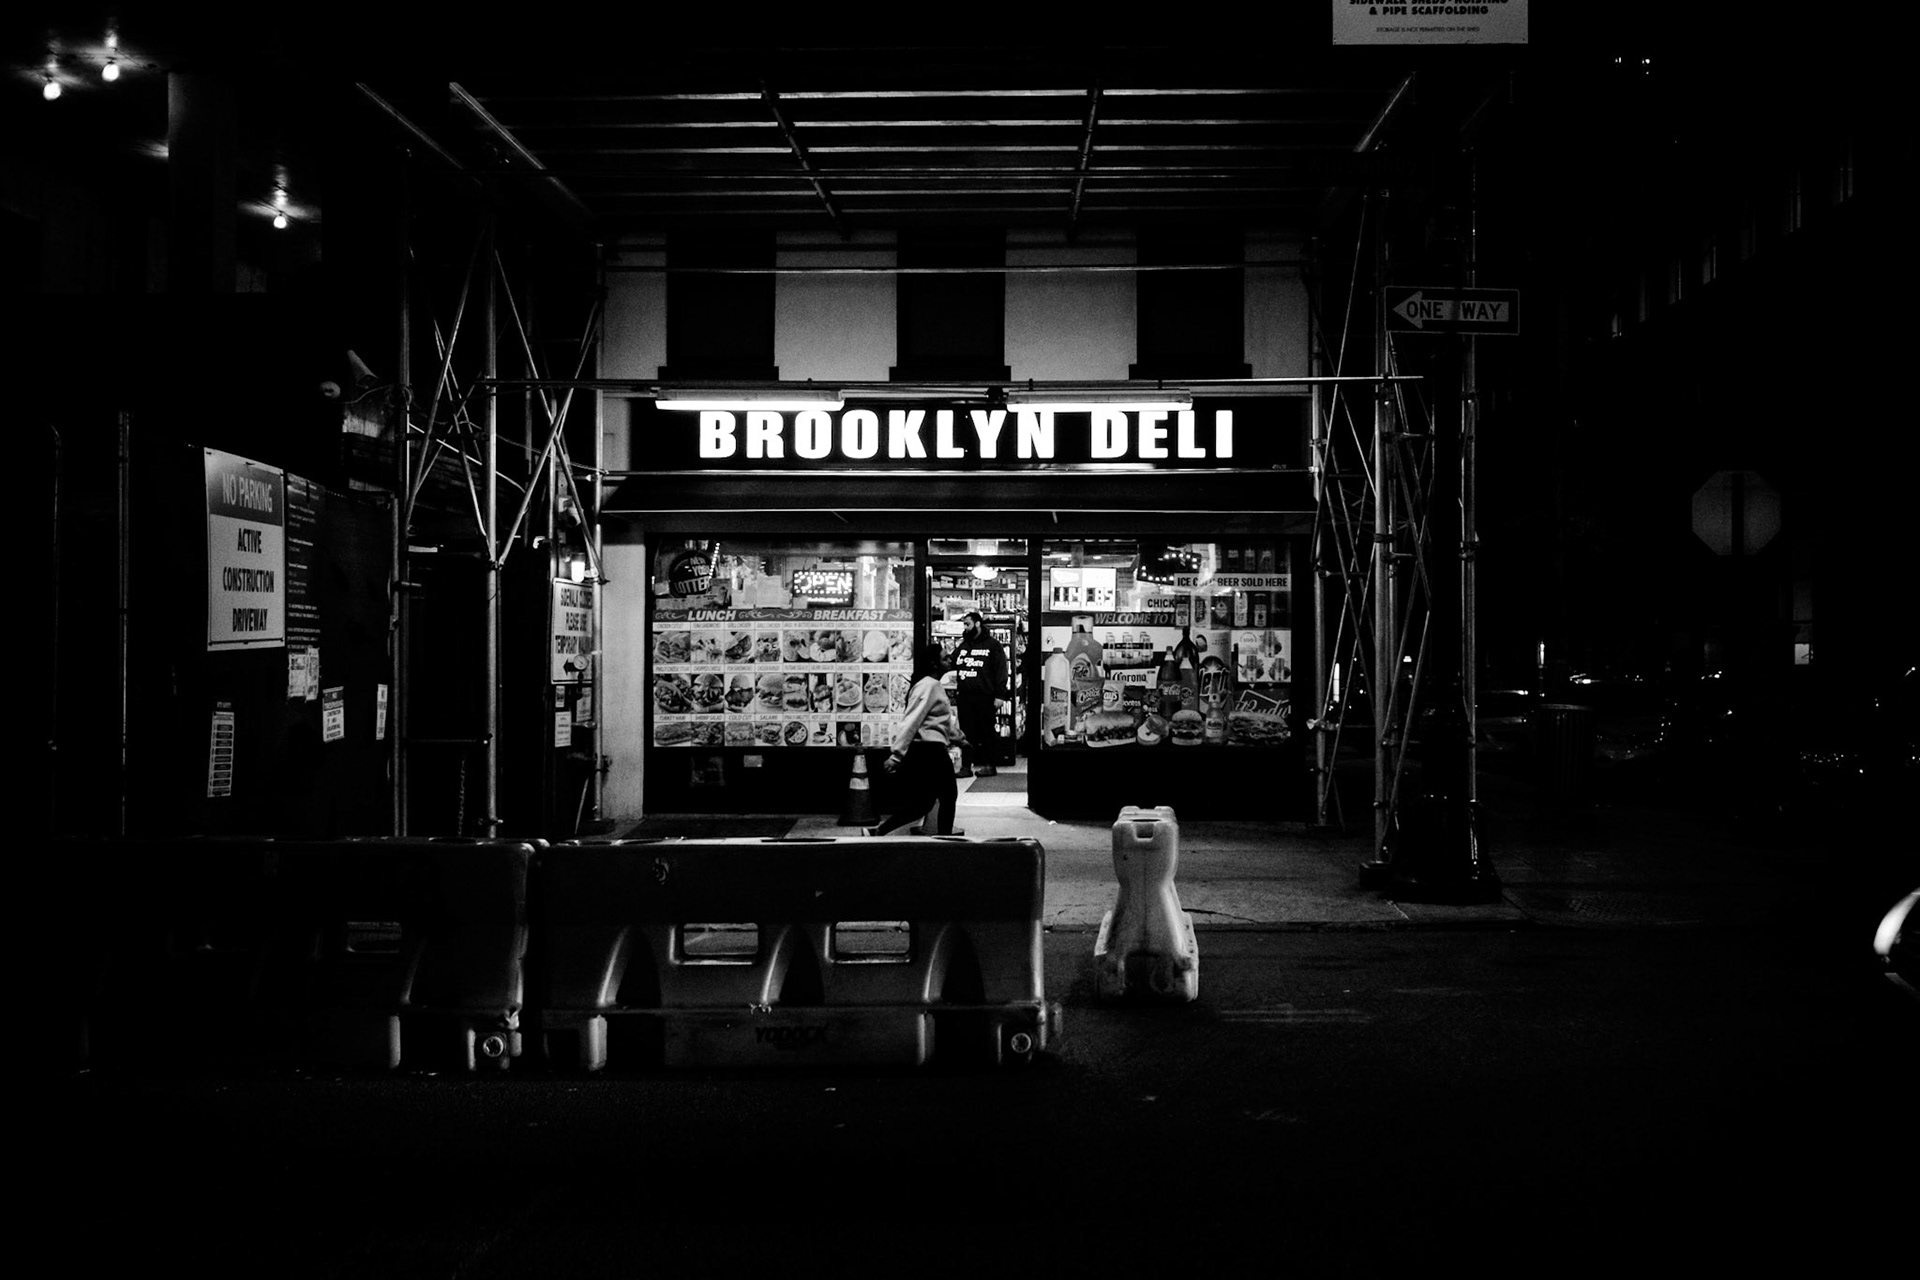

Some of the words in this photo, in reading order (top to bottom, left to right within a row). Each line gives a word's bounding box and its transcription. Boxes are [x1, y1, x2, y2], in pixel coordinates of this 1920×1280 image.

[1369, 6, 1378, 15] &
[1382, 6, 1407, 15] PIPE
[1411, 6, 1489, 15] SCAFFOLDING
[1406, 301, 1444, 319] ONE
[1461, 302, 1502, 320] WAY
[700, 409, 1055, 459] BROOKLYN
[1091, 410, 1233, 459] DELI
[222, 472, 237, 506] NO
[239, 476, 273, 513] PARKING
[237, 528, 262, 554] ACTIVE
[223, 566, 275, 593] CONSTRUCTION
[674, 576, 712, 594] LOTTER
[799, 575, 851, 591] OPEN
[1177, 577, 1191, 587] ICE
[1217, 577, 1239, 587] BEER
[1241, 577, 1263, 587] SOLD
[1265, 577, 1288, 587] HERE
[232, 608, 268, 632] DRIVEWAY
[687, 610, 737, 622] LUNCH
[813, 610, 887, 621] BREAKFAST
[1094, 612, 1151, 625] WELCOME
[1153, 613, 1168, 625] TO
[1072, 666, 1089, 680] Tide
[1112, 671, 1147, 682] Corona
[756, 1025, 829, 1042] YODOCK
